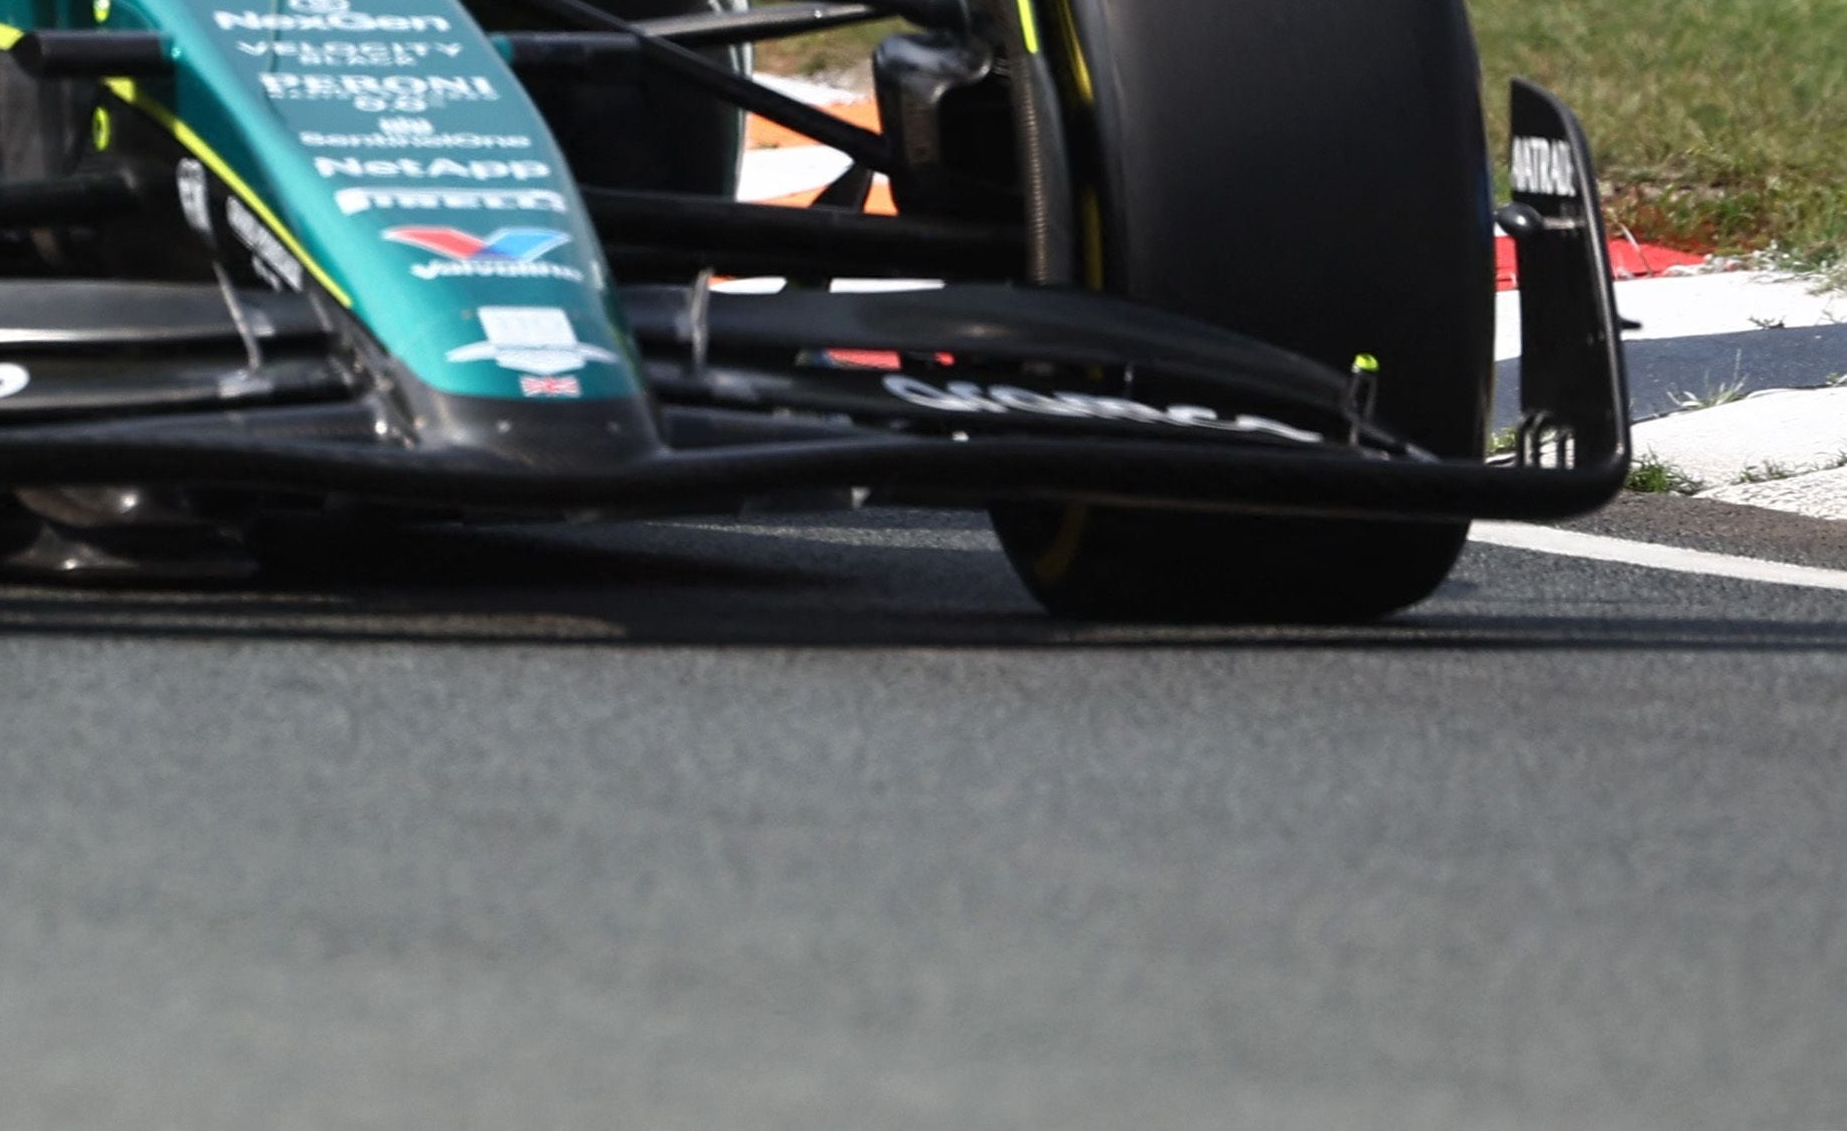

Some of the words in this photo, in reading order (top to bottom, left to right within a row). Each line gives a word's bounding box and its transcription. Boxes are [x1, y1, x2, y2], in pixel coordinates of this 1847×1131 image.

[212, 10, 452, 33] NexGen
[259, 71, 499, 98] PERONI
[313, 155, 551, 181] NetApp
